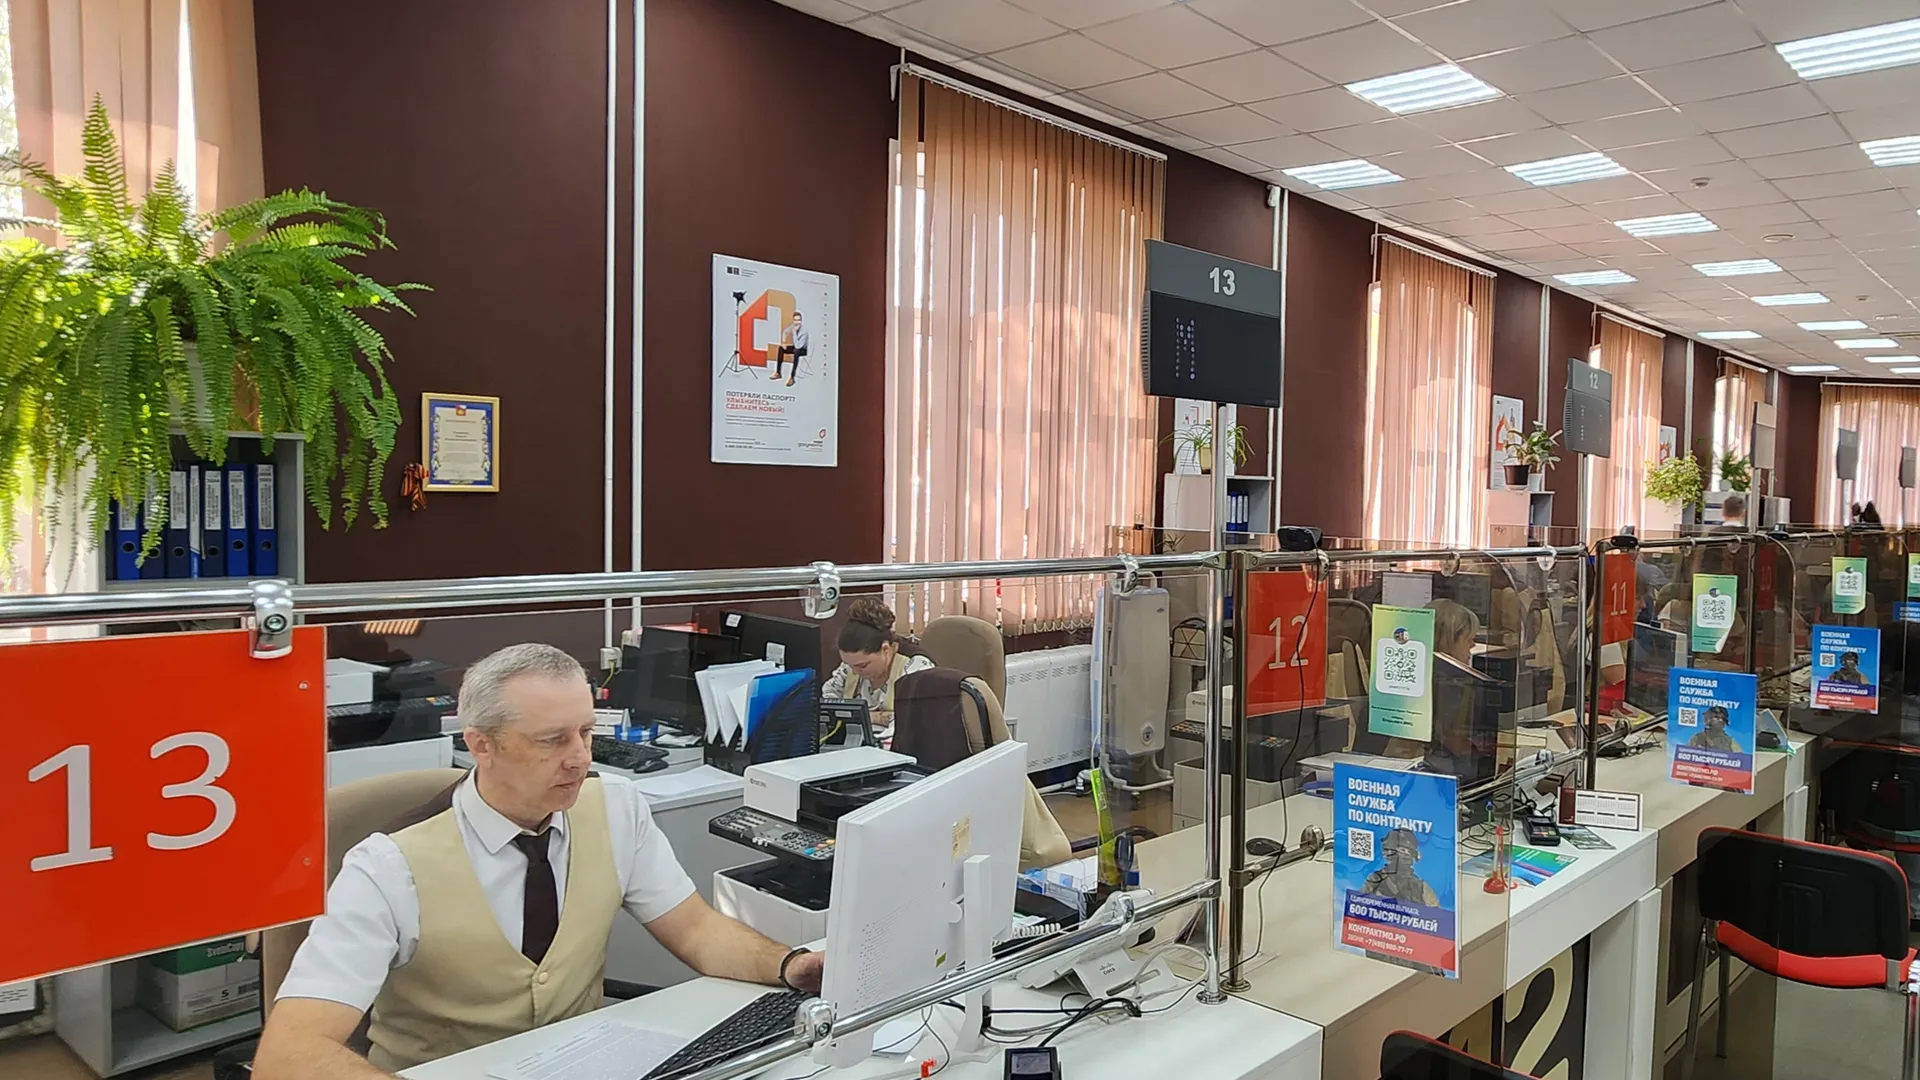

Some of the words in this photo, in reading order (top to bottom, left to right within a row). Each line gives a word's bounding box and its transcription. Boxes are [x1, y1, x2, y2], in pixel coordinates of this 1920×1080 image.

[1209, 267, 1236, 296] 13
[1589, 372, 1600, 390] 12
[726, 390, 761, 399] ПОТЕРЯЛИ
[762, 393, 796, 403] ПАСПОРТ?
[726, 403, 757, 411] СДЕЛАЕМ
[1610, 581, 1628, 616] 11
[1268, 614, 1309, 670] 12
[1679, 676, 1718, 689] ВОЕННАЯ
[1679, 686, 1714, 697] СЛУЖБА
[1679, 695, 1691, 704] ПО
[1691, 696, 1740, 710] КОНТРАКТУ
[1692, 754, 1715, 764] ТЫСЯЧ
[1716, 757, 1741, 768] РУБЛЕЙ
[1348, 777, 1401, 797] ВОЕННАЯ
[26, 730, 238, 873] 13
[1348, 793, 1396, 813] СЛУЖБА
[1348, 809, 1364, 822] ПО
[1365, 810, 1433, 834] КОНТРАКТУ
[1349, 903, 1367, 916] 600
[1368, 908, 1401, 924] ТЫСЯЧ
[1401, 915, 1439, 933] РУБЛЕЙ
[1348, 923, 1407, 943] КОНТРАКТМО.РФ
